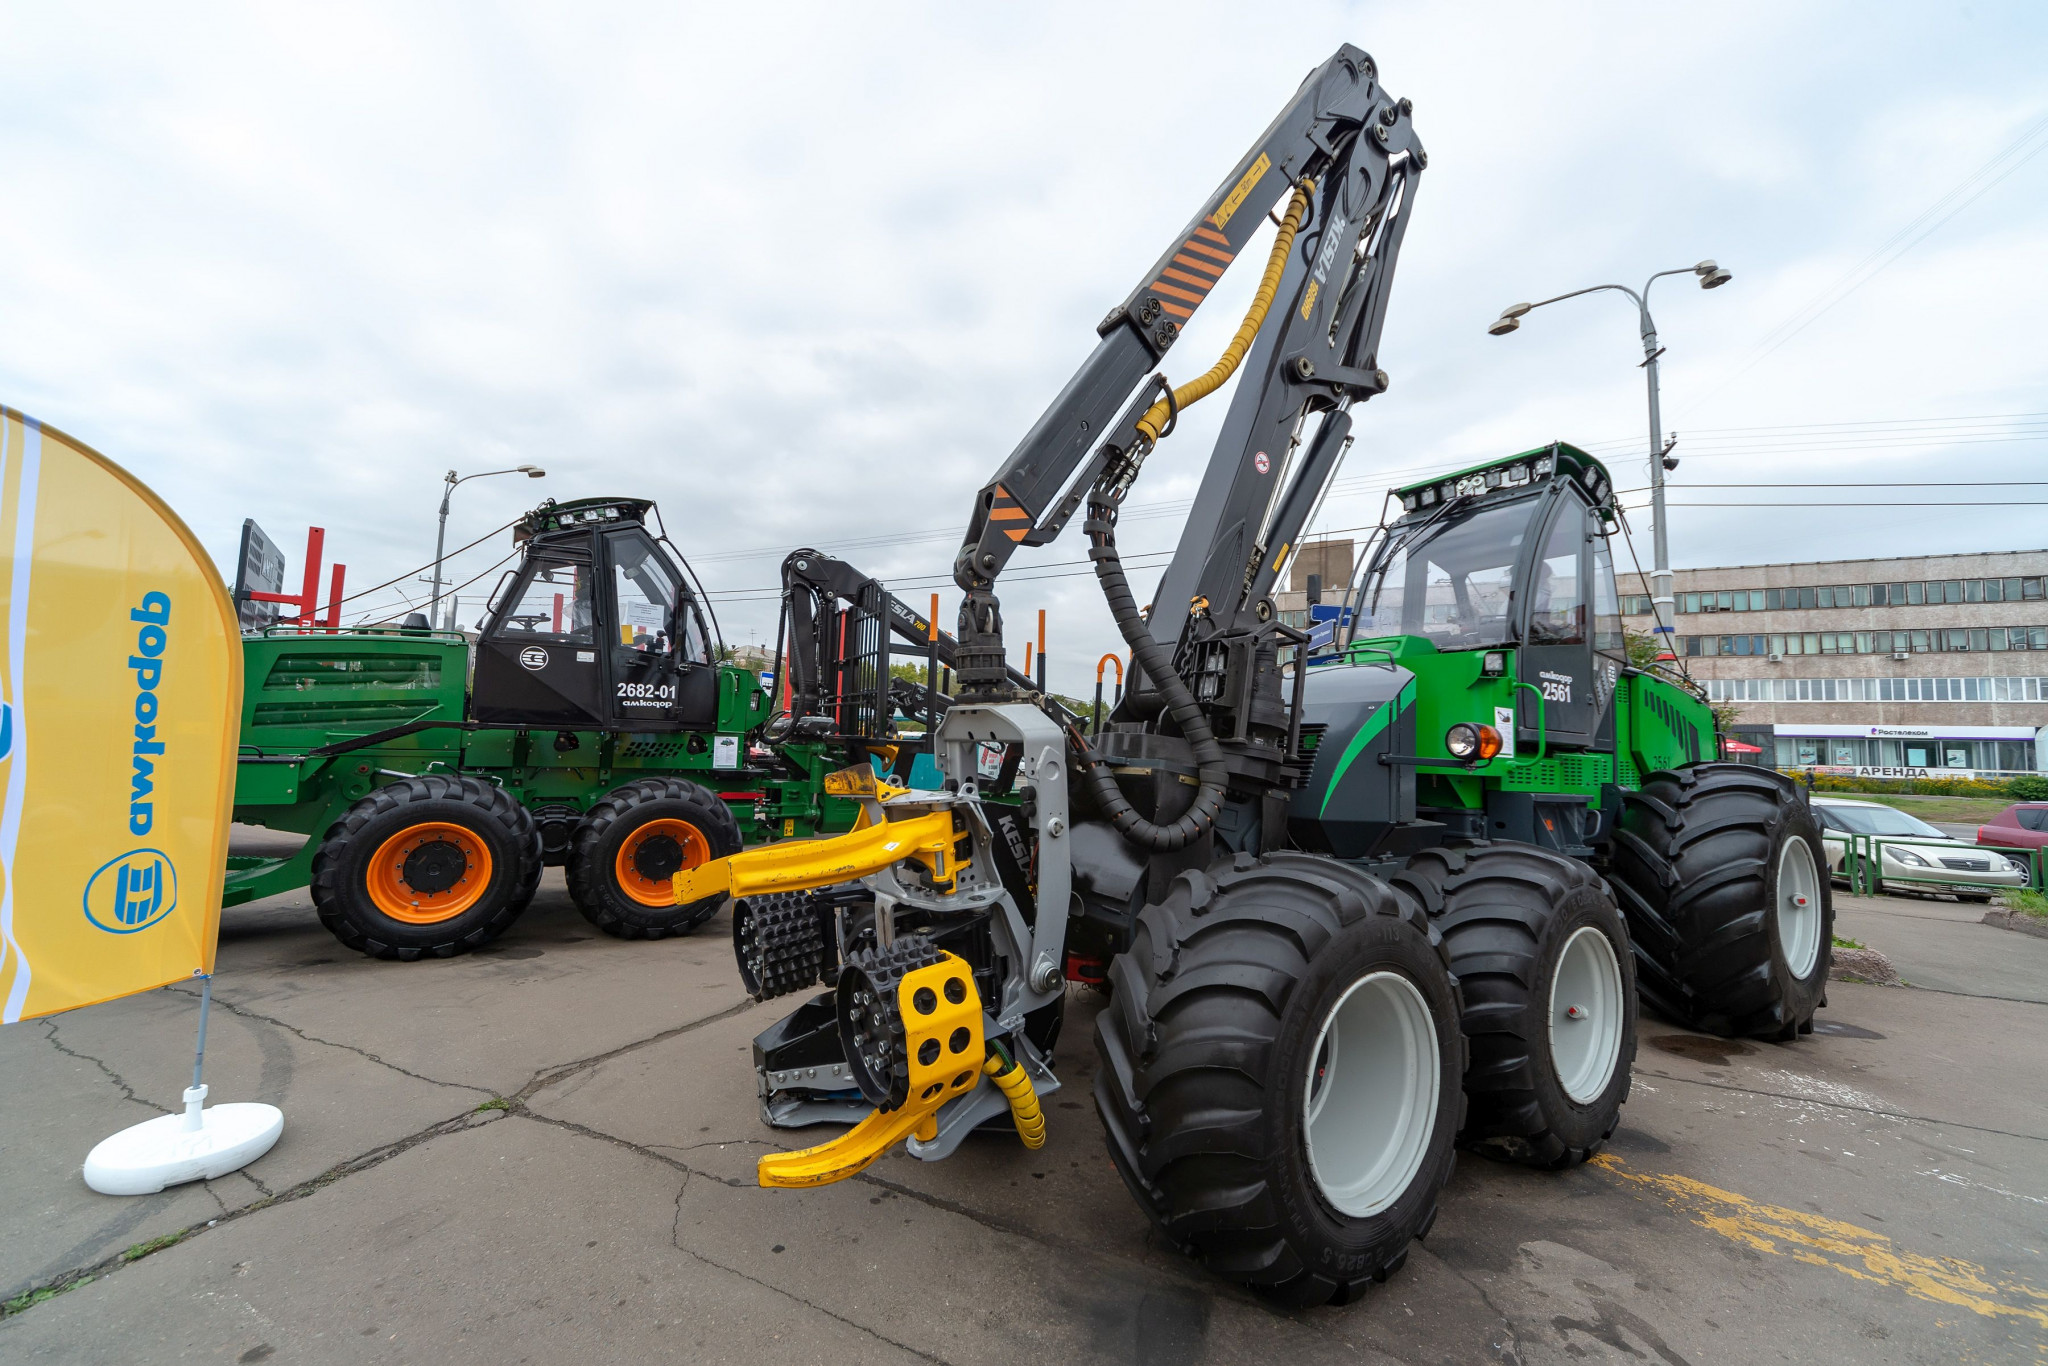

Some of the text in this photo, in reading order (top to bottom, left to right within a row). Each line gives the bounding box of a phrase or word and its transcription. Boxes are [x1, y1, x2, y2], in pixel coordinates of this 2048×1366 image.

[1314, 214, 1346, 284] KESLA
[914, 620, 927, 631] 700
[617, 682, 676, 699] 2682-01
[1543, 682, 1571, 703] 2561
[1860, 767, 1929, 778] АРЕНДА
